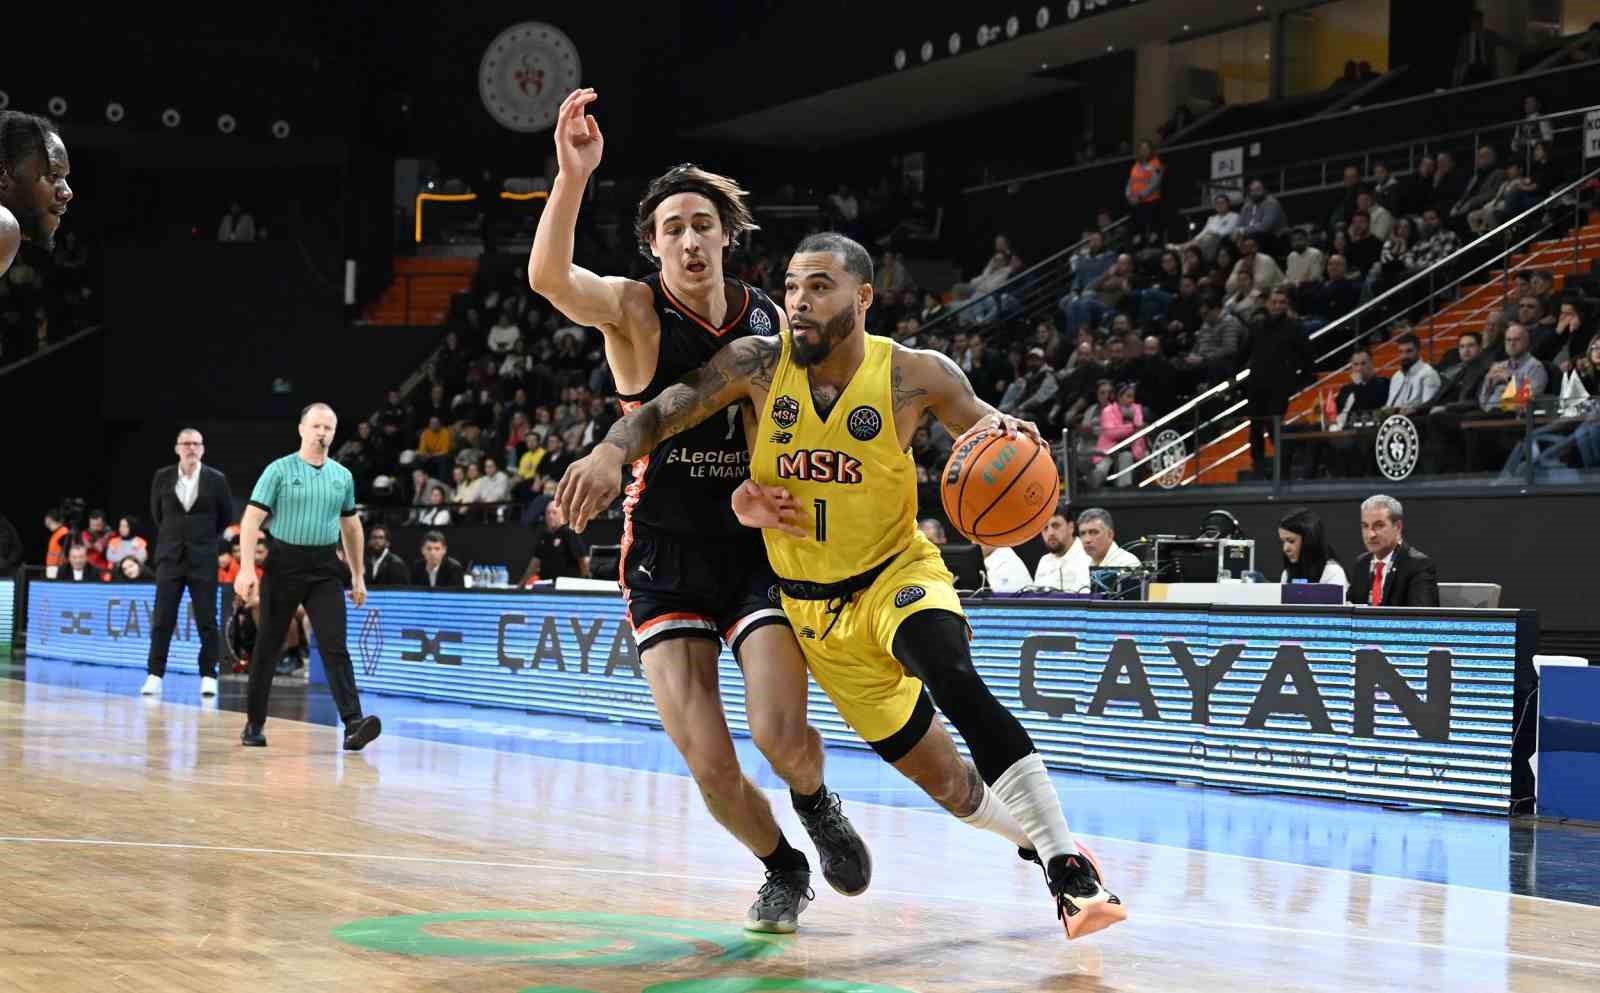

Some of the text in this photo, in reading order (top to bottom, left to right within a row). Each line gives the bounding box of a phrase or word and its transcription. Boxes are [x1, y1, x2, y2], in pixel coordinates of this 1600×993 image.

[773, 410, 796, 423] MSK
[690, 465, 705, 478] LE
[777, 449, 863, 484] MSK
[814, 498, 827, 542] 1
[1019, 634, 1452, 743] ÇAYAN
